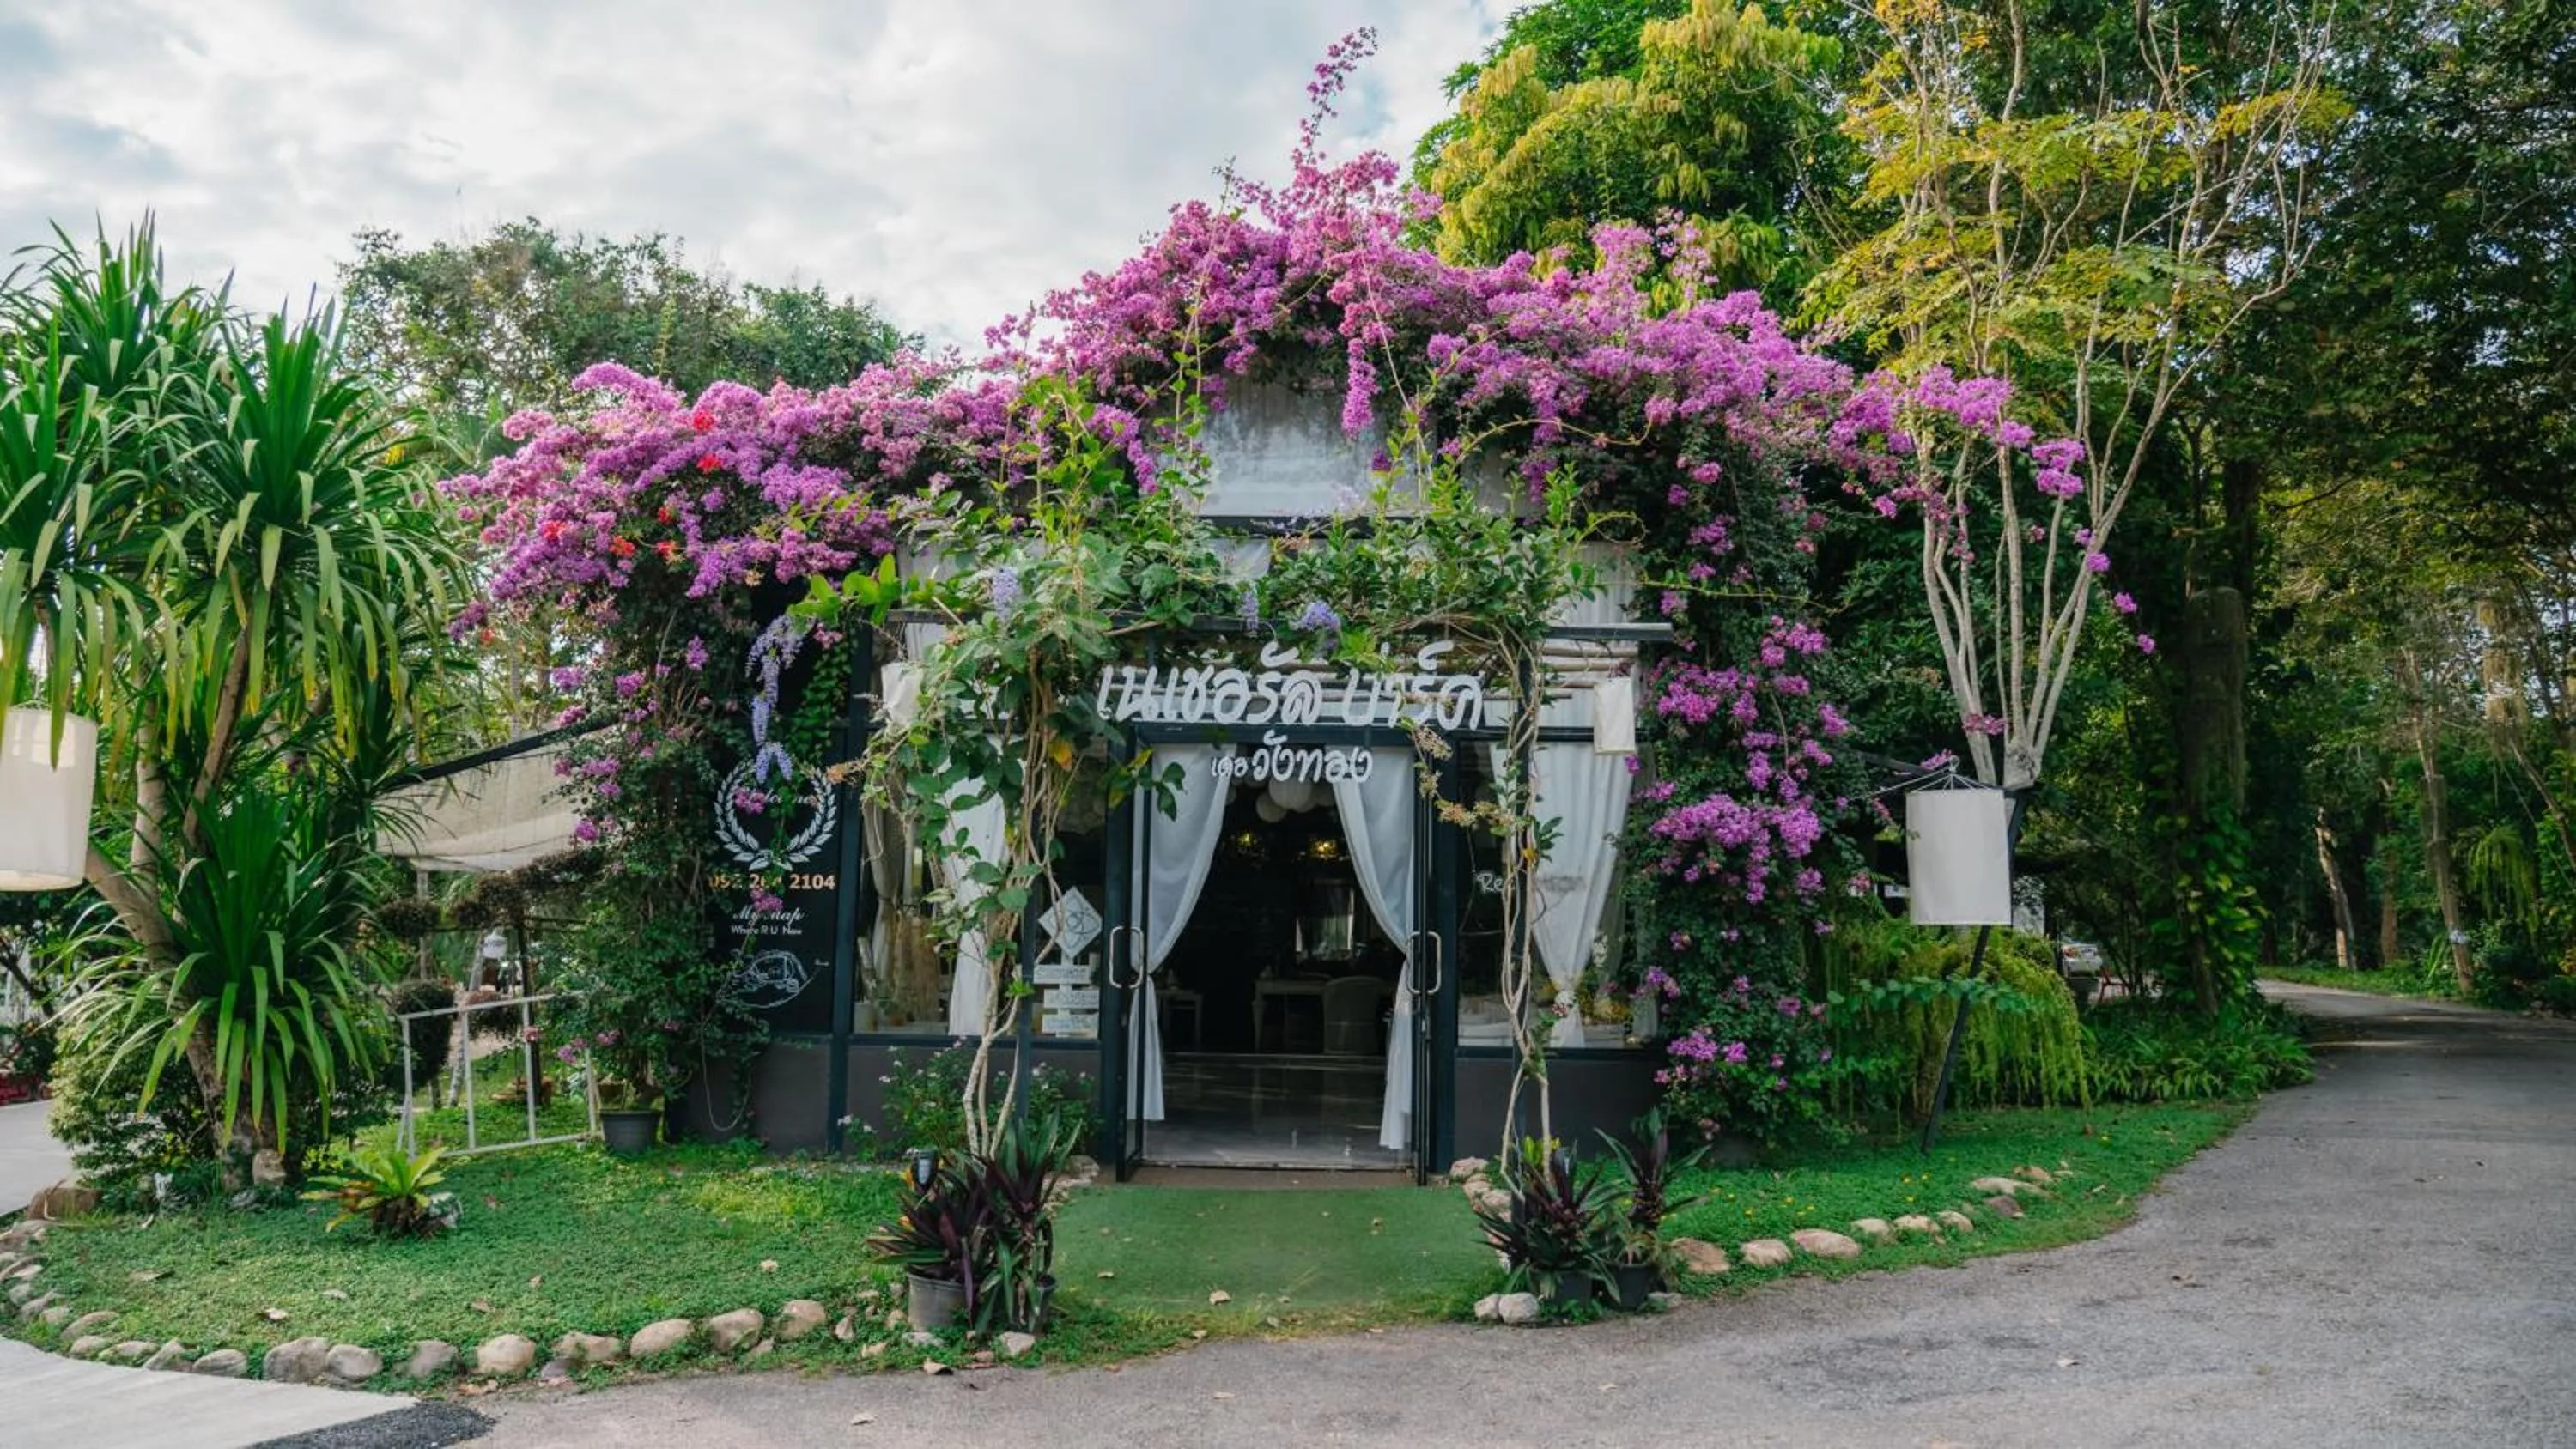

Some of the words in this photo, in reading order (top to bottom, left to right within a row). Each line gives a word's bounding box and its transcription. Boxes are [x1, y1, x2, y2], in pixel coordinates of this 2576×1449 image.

[1097, 641, 1323, 725] เนเชอรัล
[1252, 730, 1374, 783] วังทอง
[789, 873, 835, 890] 2104
